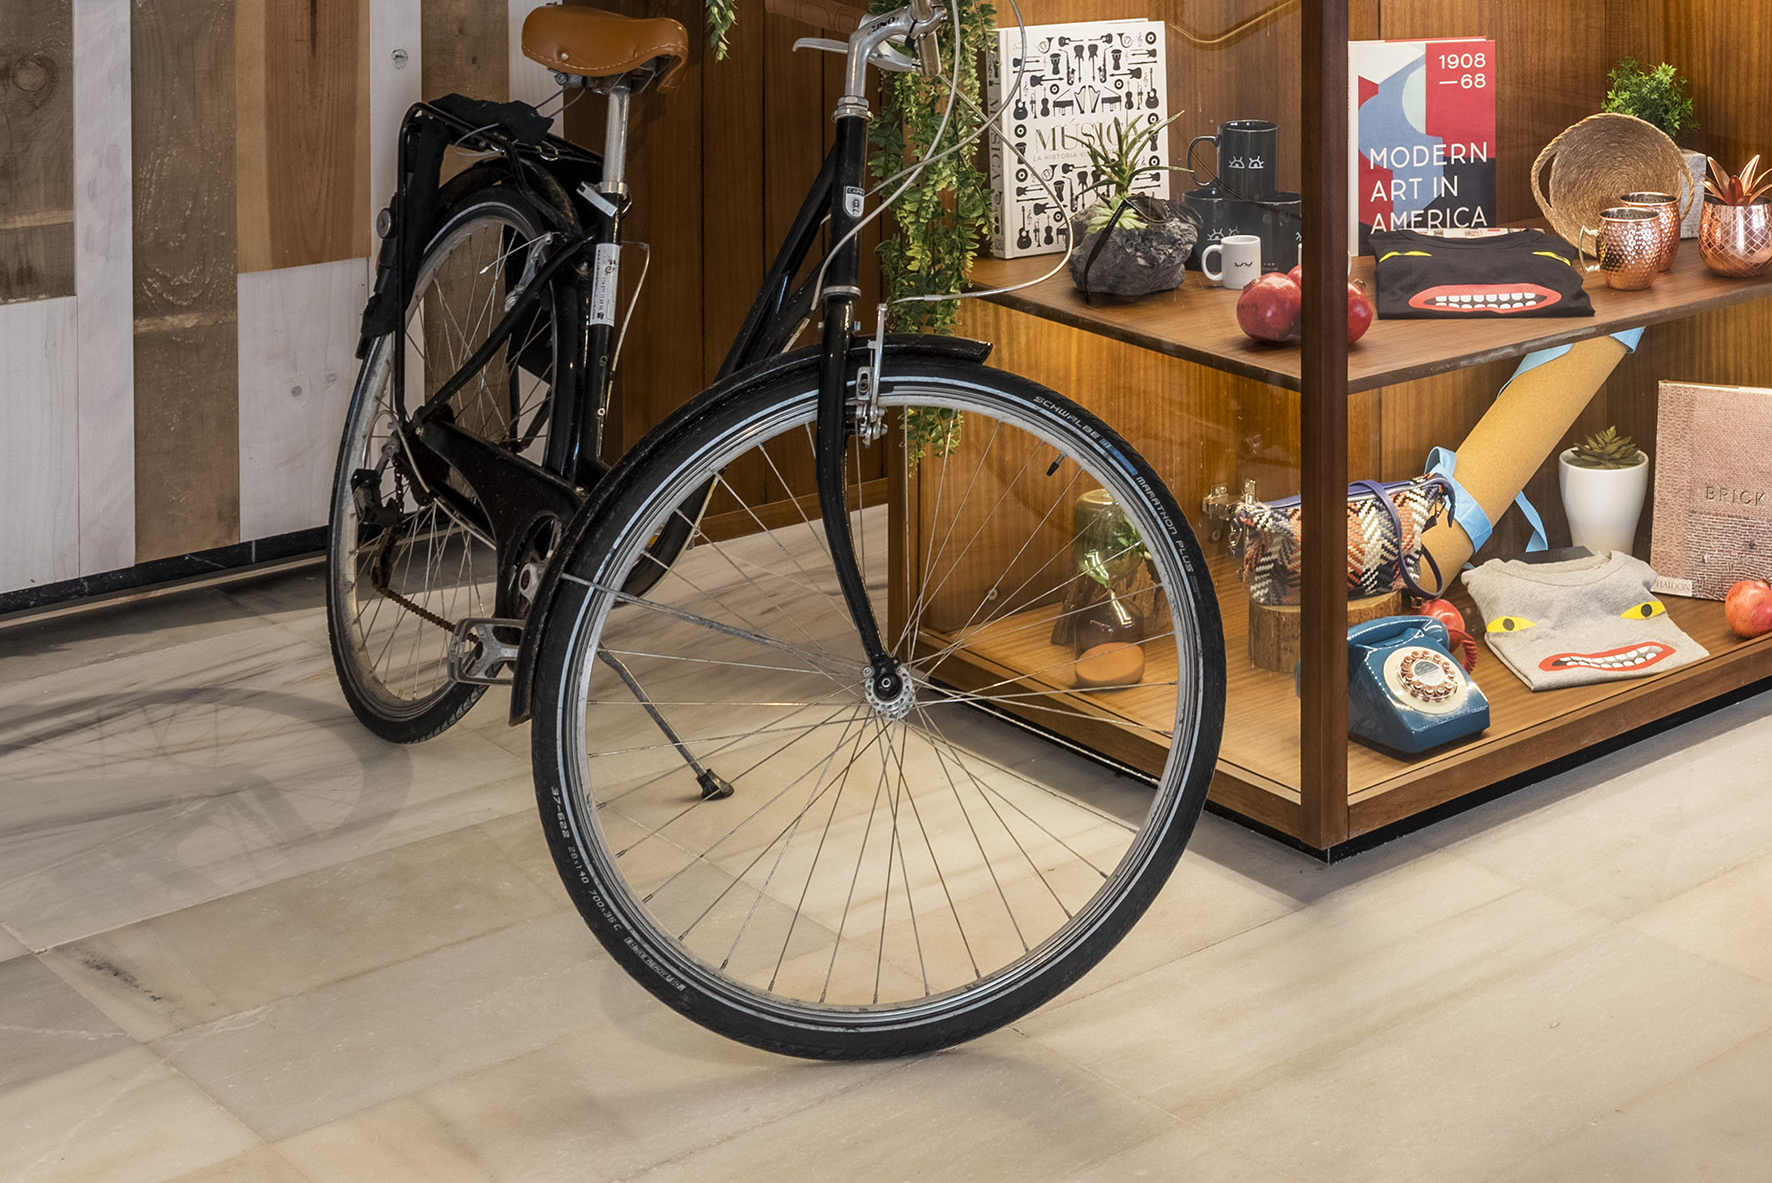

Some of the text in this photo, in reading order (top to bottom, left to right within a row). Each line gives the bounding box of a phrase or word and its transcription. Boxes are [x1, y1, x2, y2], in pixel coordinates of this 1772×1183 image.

[1438, 52, 1487, 69] 1908
[1369, 141, 1488, 170] MODERN
[1370, 175, 1458, 202] ART IN
[1370, 205, 1488, 235] AMERICA
[1033, 395, 1101, 440] SCHWALBE
[1705, 485, 1766, 506] BRICK
[1136, 476, 1194, 573] MARATHON PLUS
[1653, 578, 1691, 592] HAIDON
[551, 786, 571, 839] 37-622
